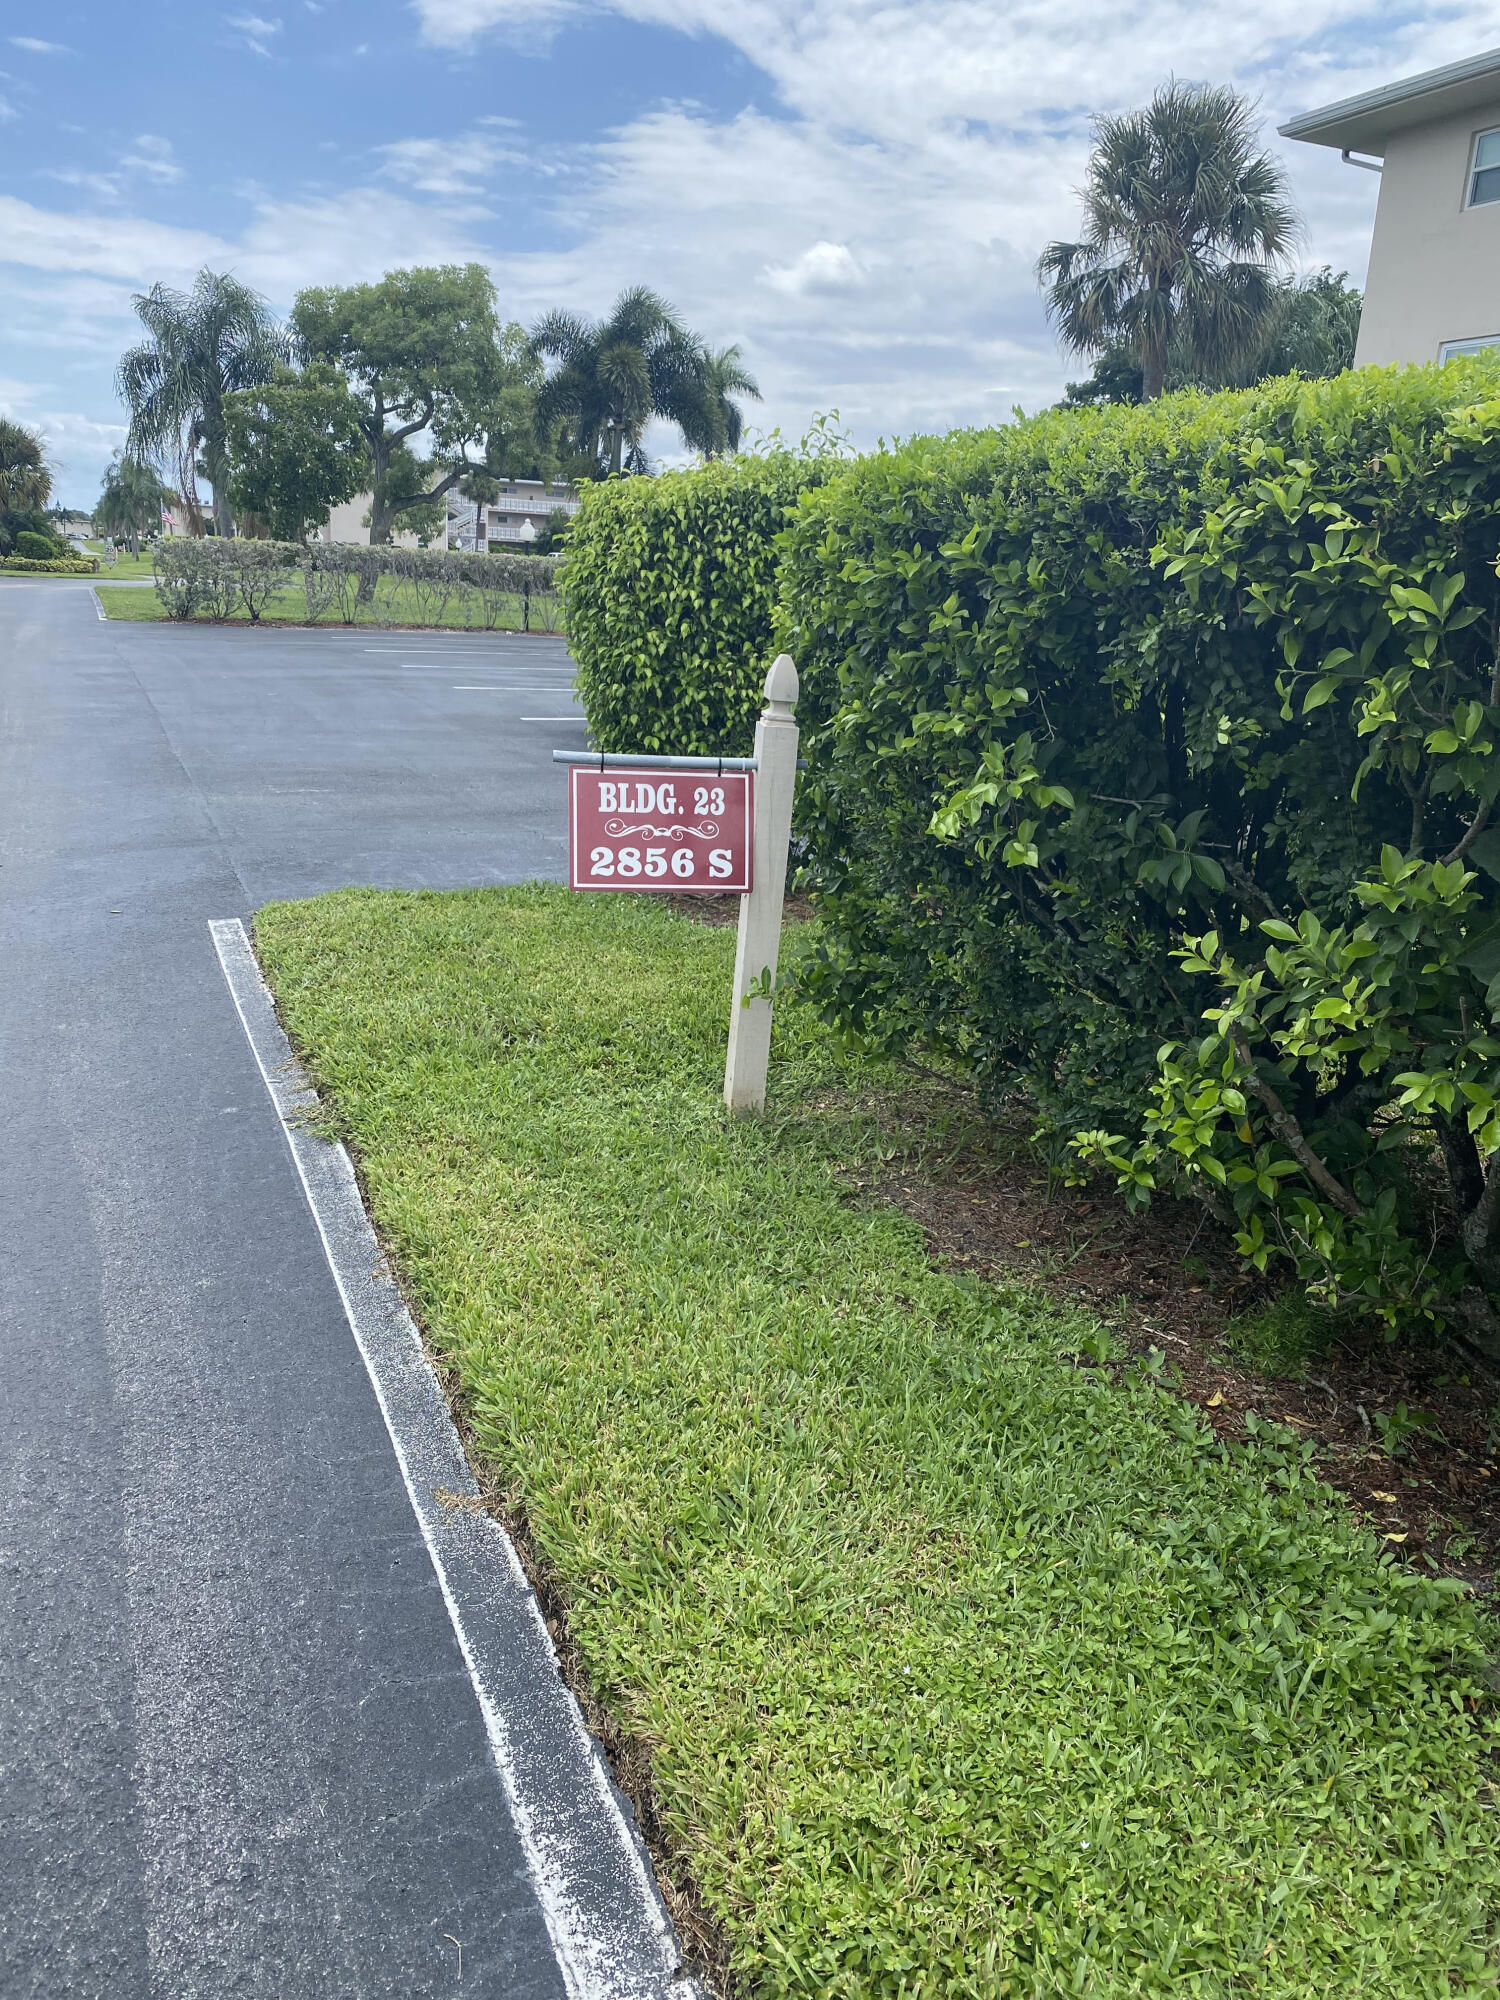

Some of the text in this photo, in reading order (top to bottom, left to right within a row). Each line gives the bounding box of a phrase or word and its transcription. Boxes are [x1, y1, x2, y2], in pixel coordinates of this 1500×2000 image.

[597, 782, 726, 816] BLDG. 23
[590, 846, 734, 878] 2856 S
